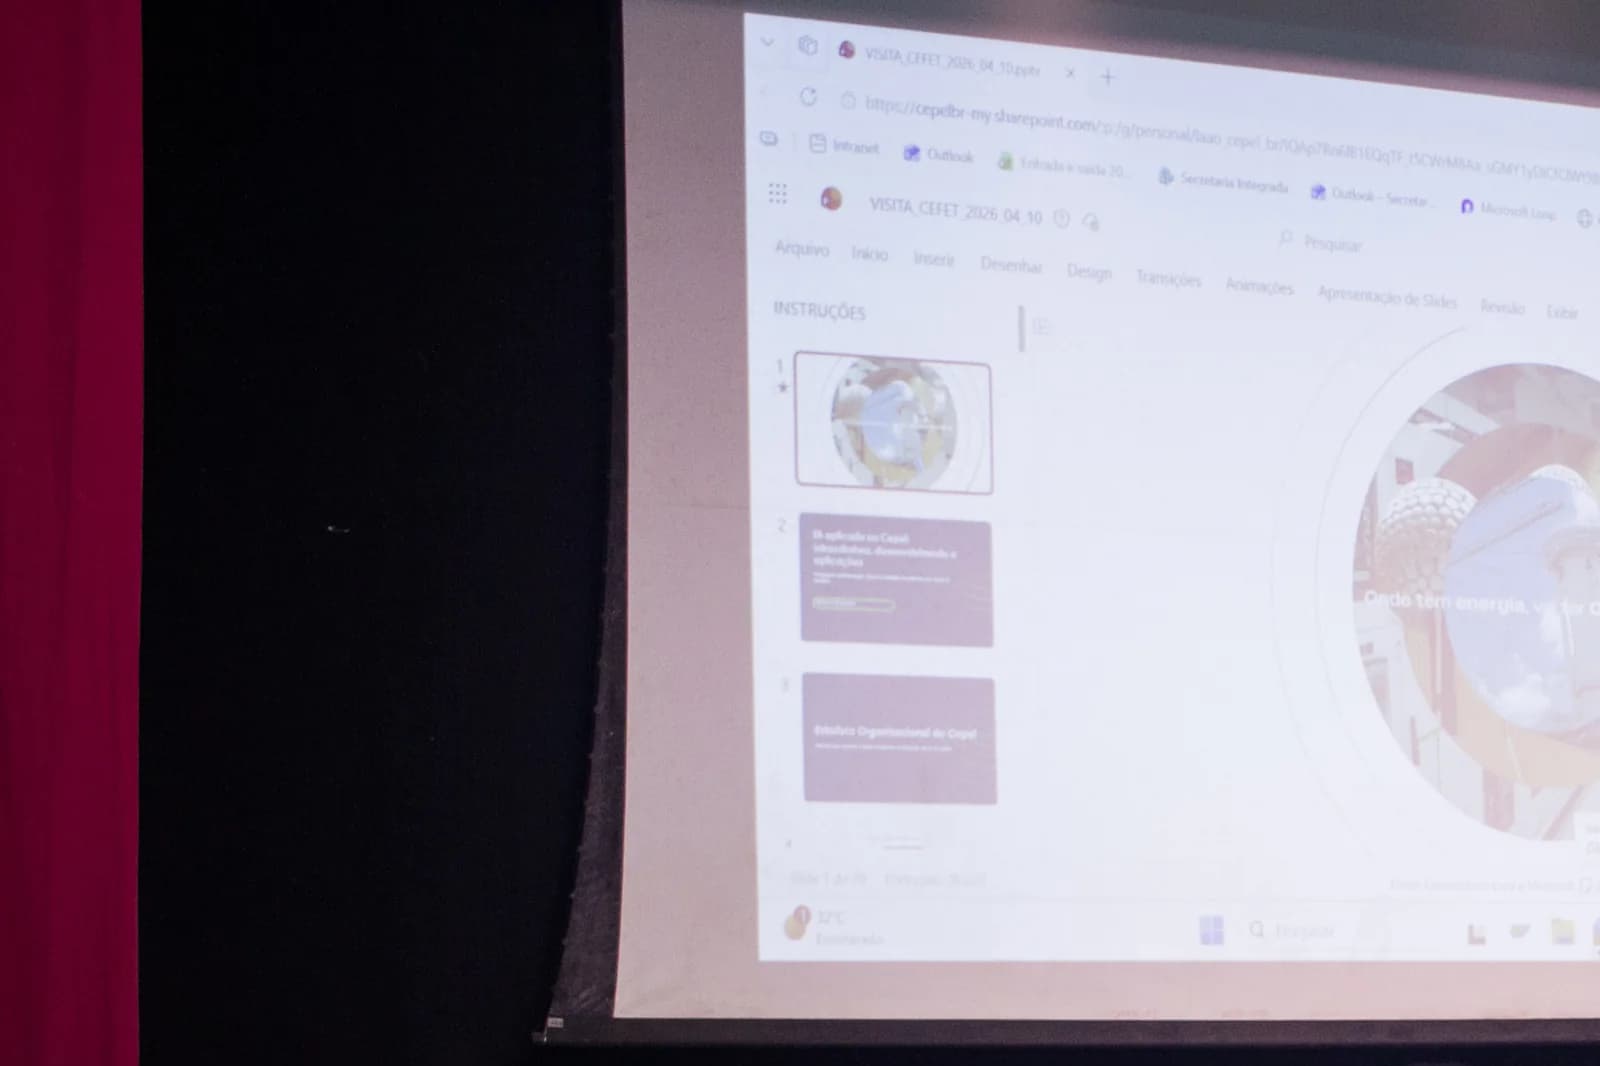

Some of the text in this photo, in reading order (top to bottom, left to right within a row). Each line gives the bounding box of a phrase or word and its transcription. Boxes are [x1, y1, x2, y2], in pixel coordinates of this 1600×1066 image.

[927, 147, 974, 164] Outlook
[1180, 171, 1234, 189] Secretaria
[1332, 186, 1374, 202] Outlook
[869, 196, 1043, 226] VISITA_CEFET_2026_04_10
[776, 239, 831, 259] Arquivo
[1304, 232, 1364, 254] Pesquisar
[851, 245, 889, 263] Início
[913, 250, 955, 268] Inserir
[980, 255, 1043, 275] Desenhar
[1066, 263, 1113, 283] Design
[1136, 268, 1202, 289] Transições
[1226, 276, 1296, 297] Animações
[1317, 284, 1401, 308] Apresentação
[773, 299, 867, 322] INSTRUÇÕES
[1480, 298, 1526, 316] Revisão
